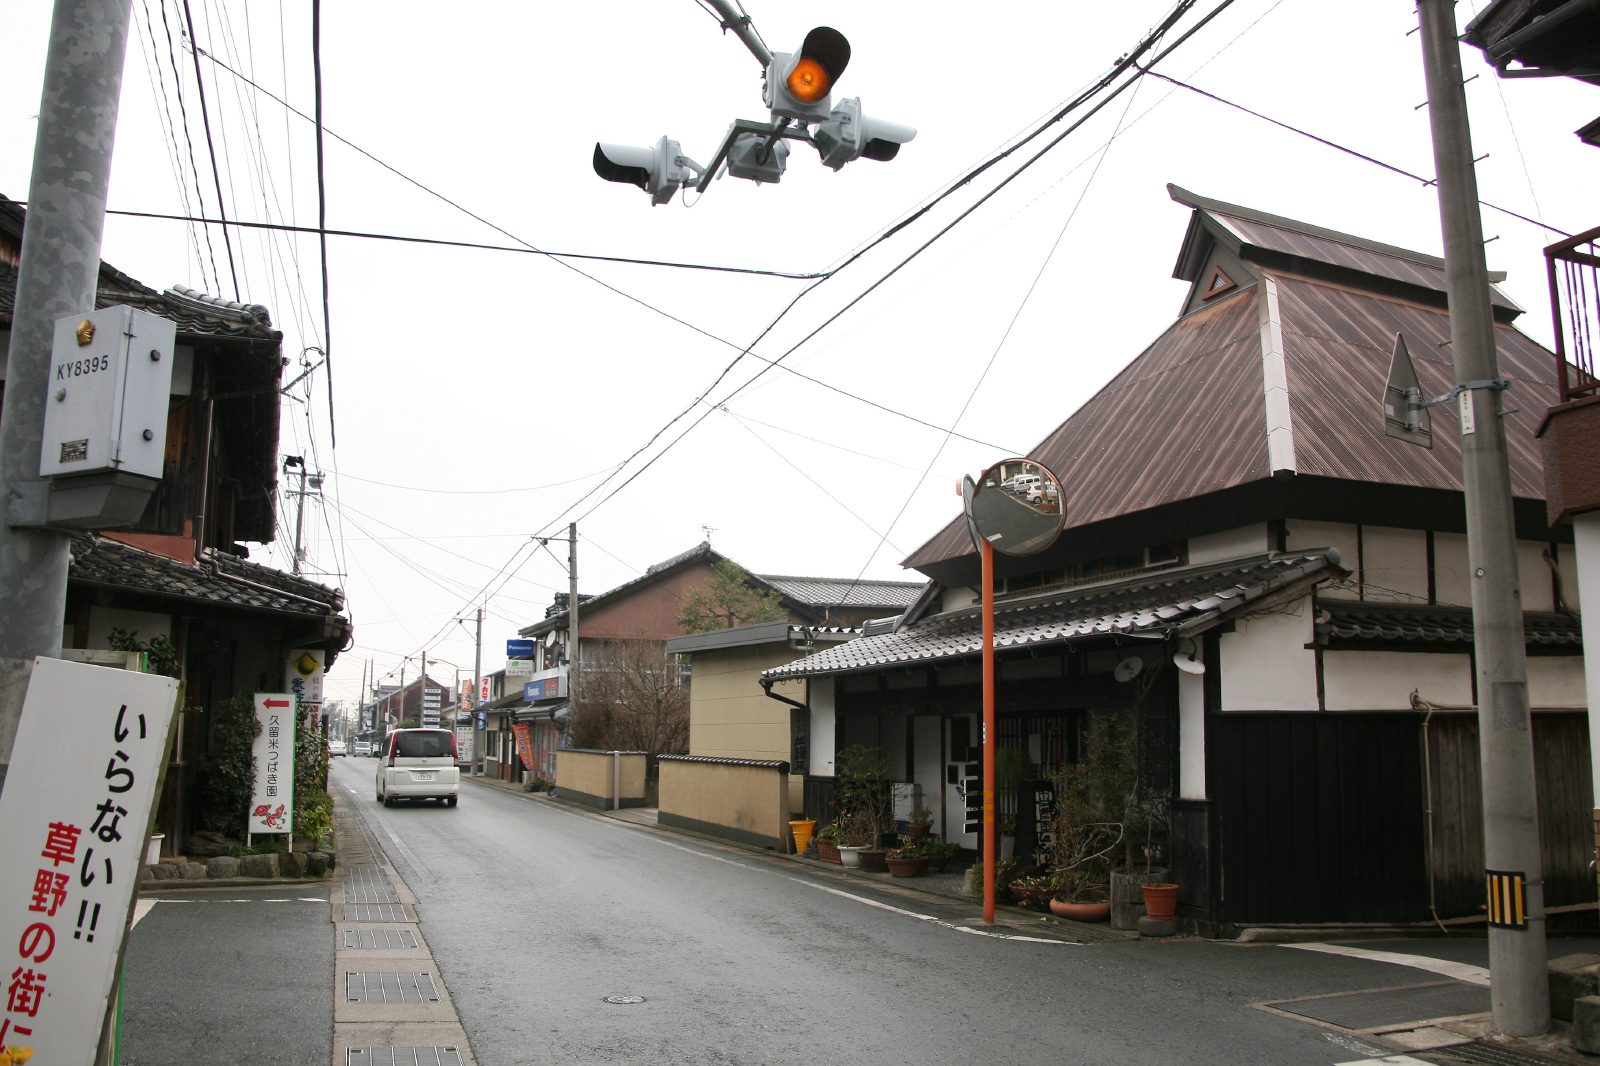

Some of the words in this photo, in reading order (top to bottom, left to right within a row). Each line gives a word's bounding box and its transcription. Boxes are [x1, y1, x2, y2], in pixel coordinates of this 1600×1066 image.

[57, 354, 109, 380] KY8395
[73, 704, 147, 944] いらない!!
